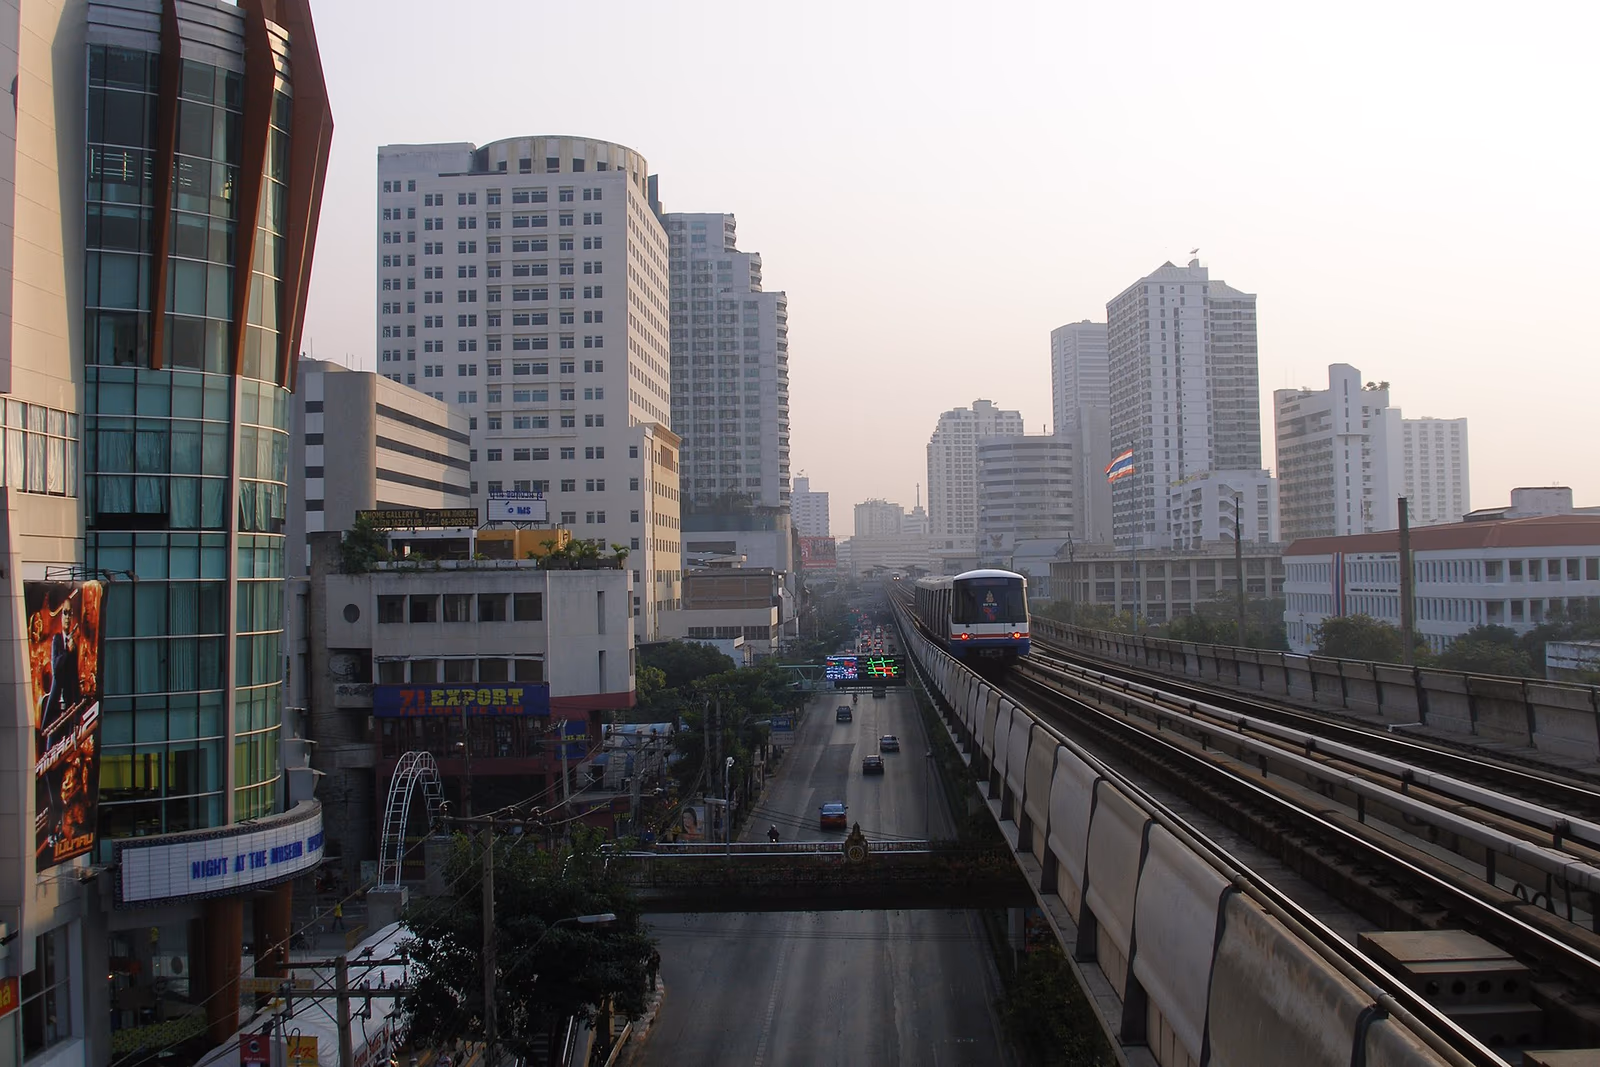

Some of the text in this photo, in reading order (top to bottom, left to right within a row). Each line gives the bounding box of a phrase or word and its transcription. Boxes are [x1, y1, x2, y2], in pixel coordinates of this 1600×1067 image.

[430, 689, 523, 706] EXPORT
[192, 857, 229, 879] NIGHT
[235, 854, 246, 872] AT
[249, 850, 267, 870] THE
[271, 841, 303, 864] MUSEUM
